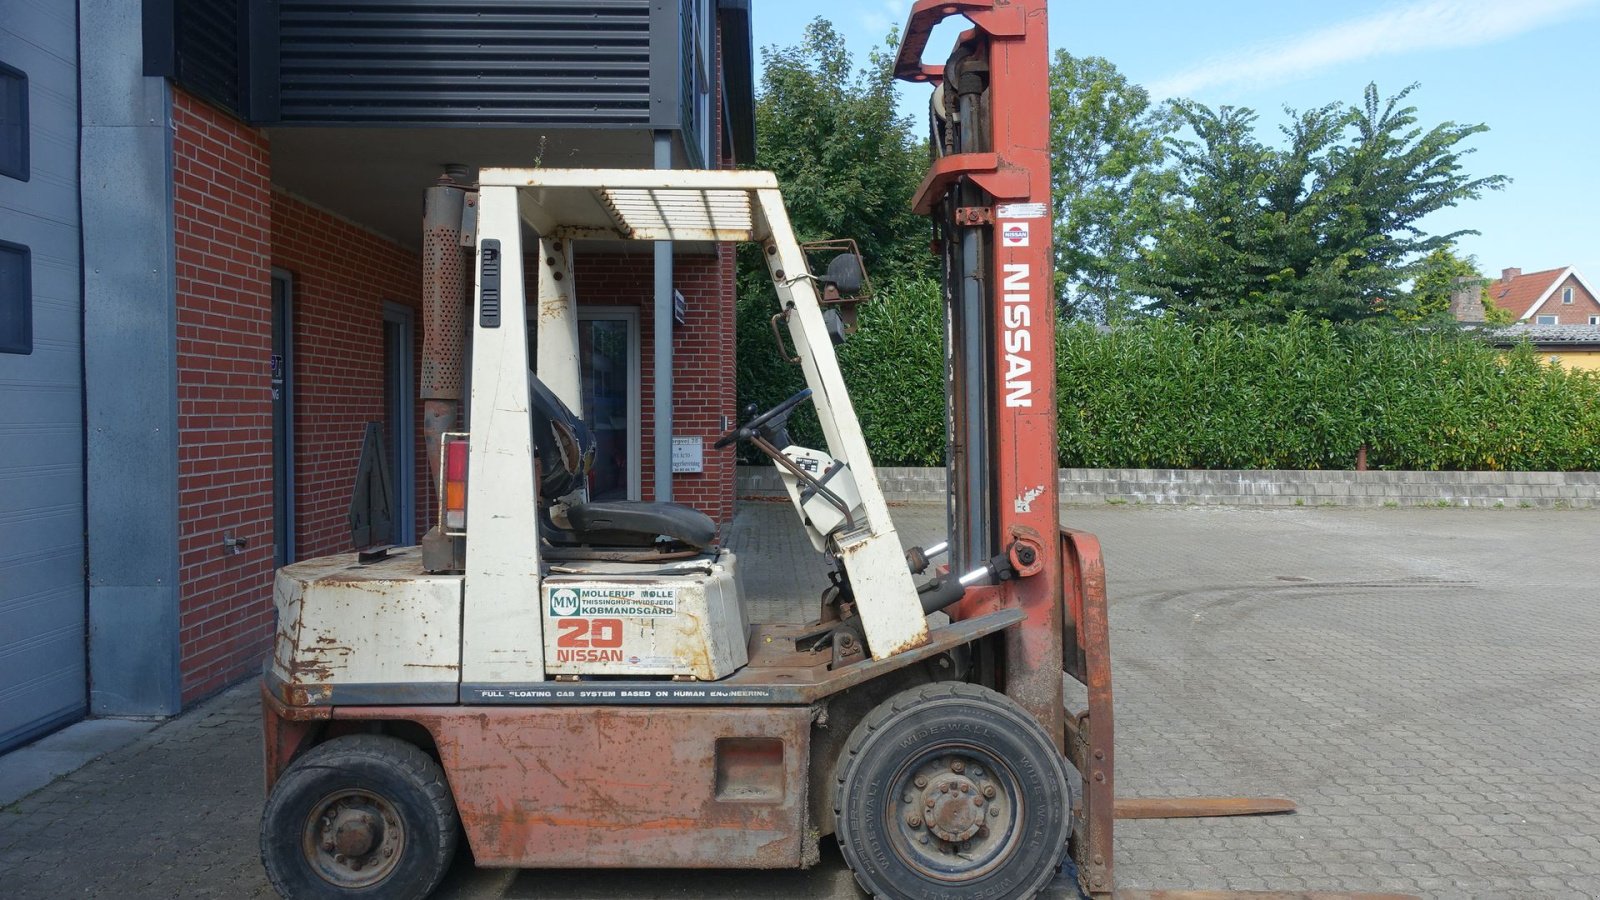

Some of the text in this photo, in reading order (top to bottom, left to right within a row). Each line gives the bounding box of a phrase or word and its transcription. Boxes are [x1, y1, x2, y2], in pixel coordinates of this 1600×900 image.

[1003, 263, 1032, 408] NISSAN
[581, 590, 673, 598] MOLLERUP MØLLE
[553, 596, 577, 609] MM
[581, 605, 674, 615] KØBMANDSGÅRD
[557, 618, 623, 648] 20
[557, 649, 623, 662] NISSAN
